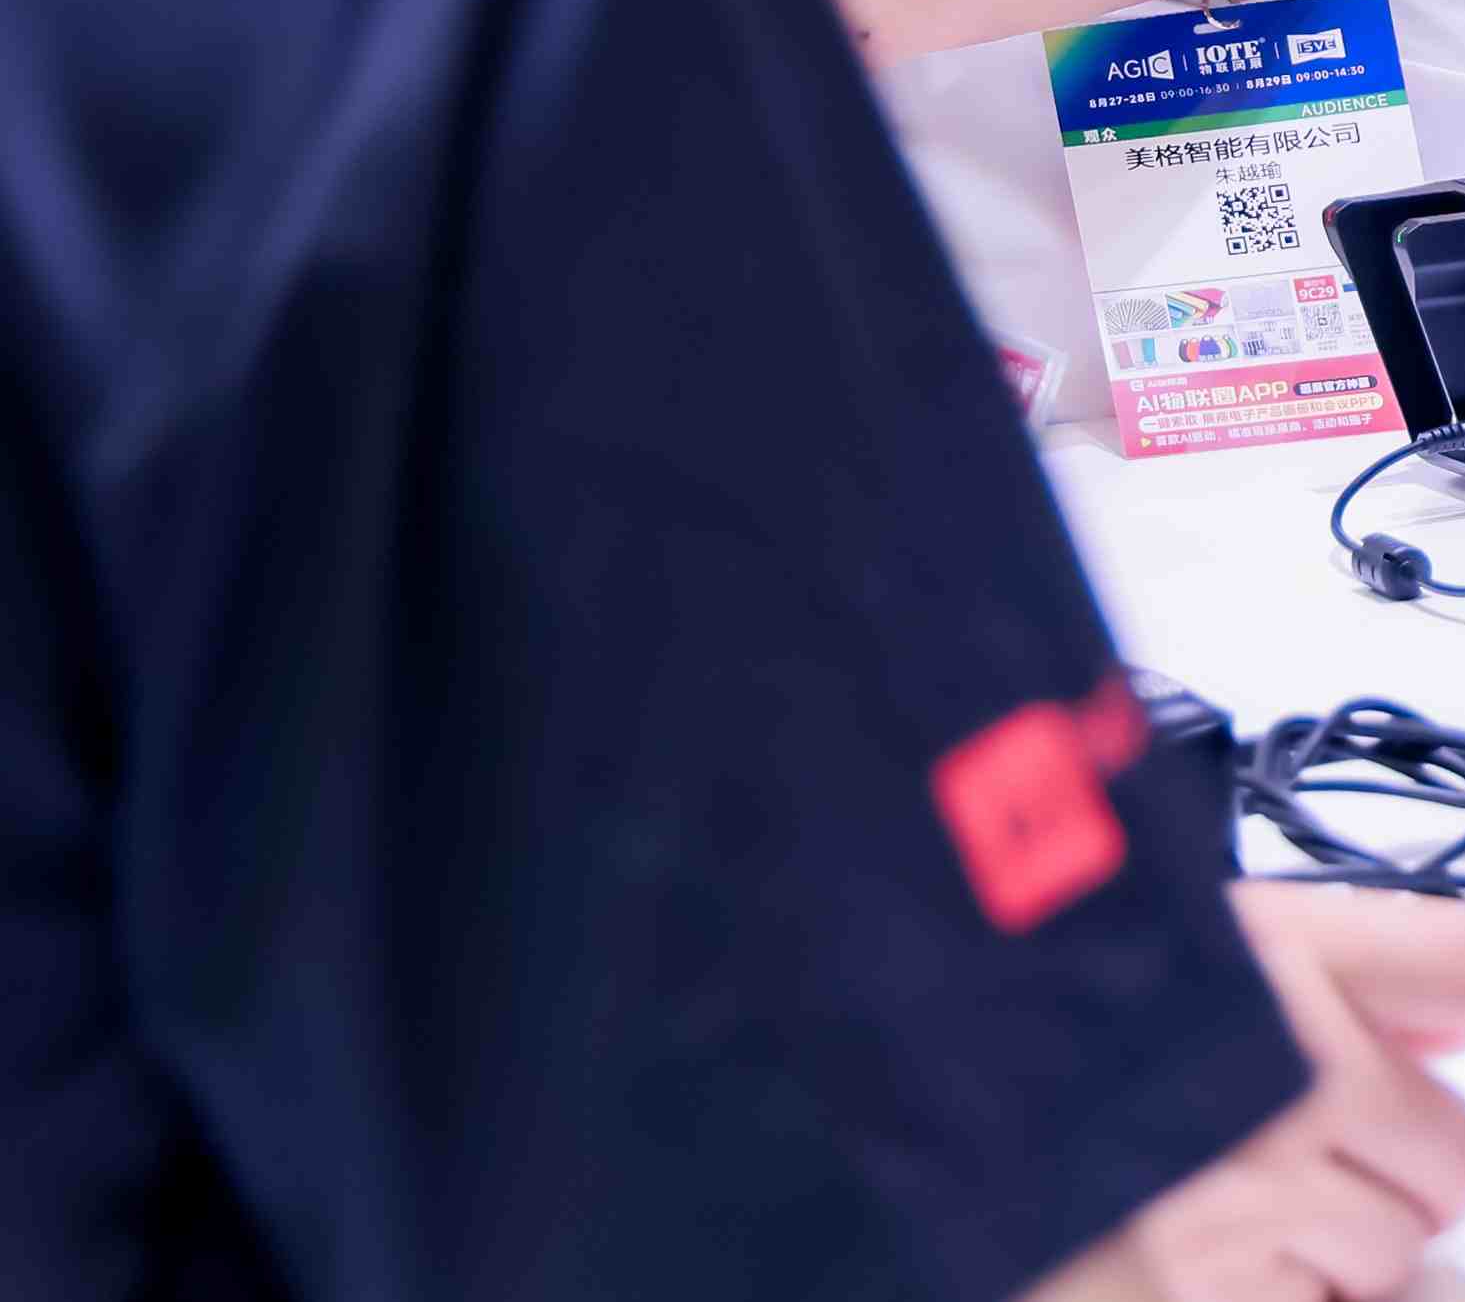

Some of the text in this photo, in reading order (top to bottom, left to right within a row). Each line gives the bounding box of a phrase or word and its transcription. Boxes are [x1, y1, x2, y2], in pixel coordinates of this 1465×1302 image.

[1107, 50, 1174, 82] AGIC
[1301, 93, 1389, 117] AUDIENCE
[1125, 122, 1361, 171] 美格智能有限公司
